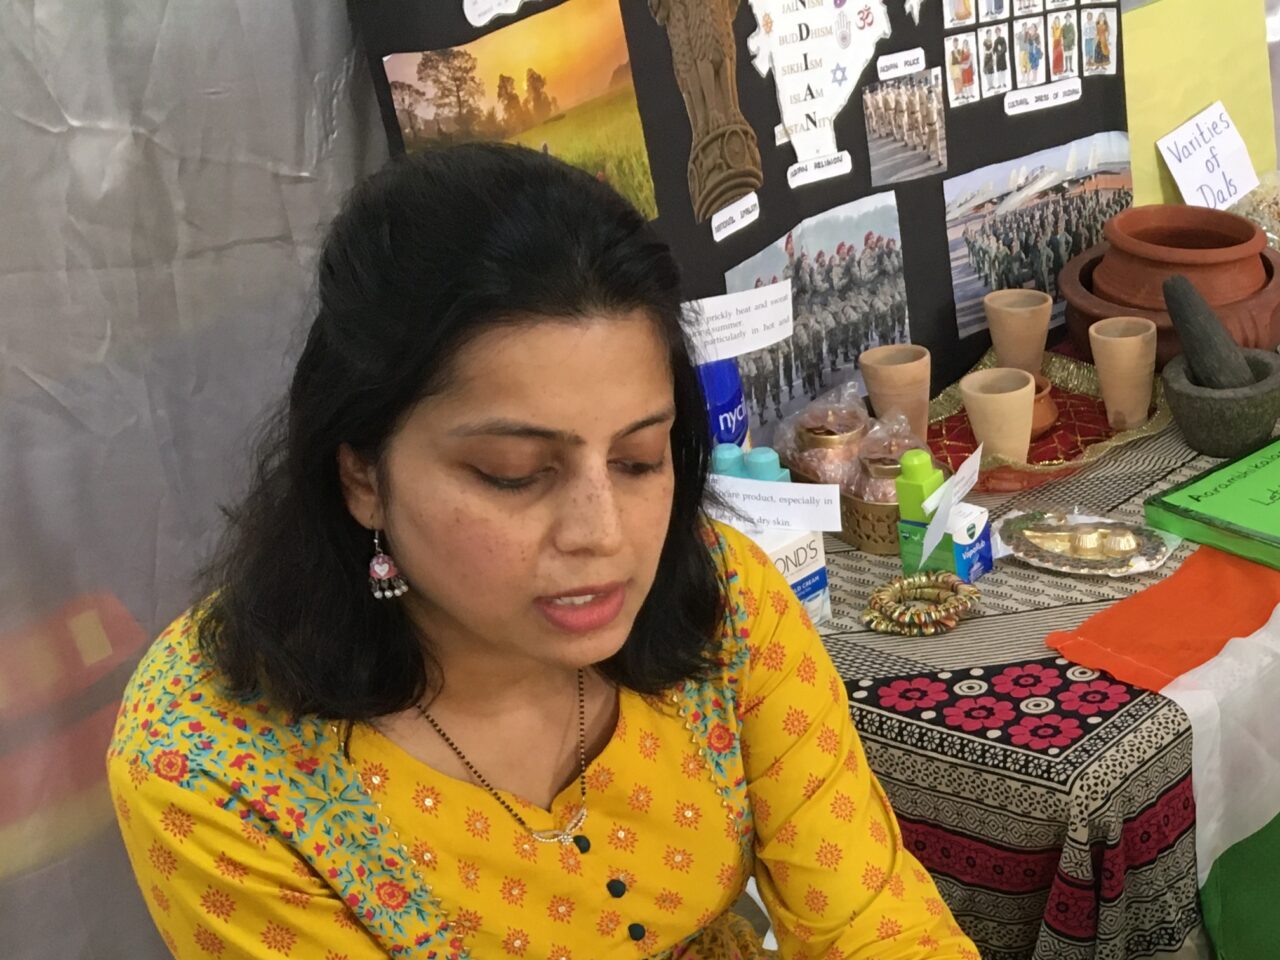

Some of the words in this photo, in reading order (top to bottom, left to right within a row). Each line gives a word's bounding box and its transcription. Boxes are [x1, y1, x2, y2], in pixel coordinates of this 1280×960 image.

[779, 22, 833, 46] BUDDHISM
[781, 53, 823, 76] SIKHISM
[789, 82, 824, 105] ISLAM
[1166, 112, 1230, 164] Varities
[1205, 146, 1221, 174] of
[1196, 171, 1239, 209] Dals
[705, 309, 733, 324] prickly
[735, 305, 752, 316] heat
[753, 299, 768, 311] and
[703, 328, 747, 347] particularly
[751, 327, 760, 336] in
[763, 321, 776, 332] hot
[778, 315, 791, 327] and
[778, 496, 823, 507] especially
[823, 497, 834, 506] in
[756, 517, 771, 528] dry
